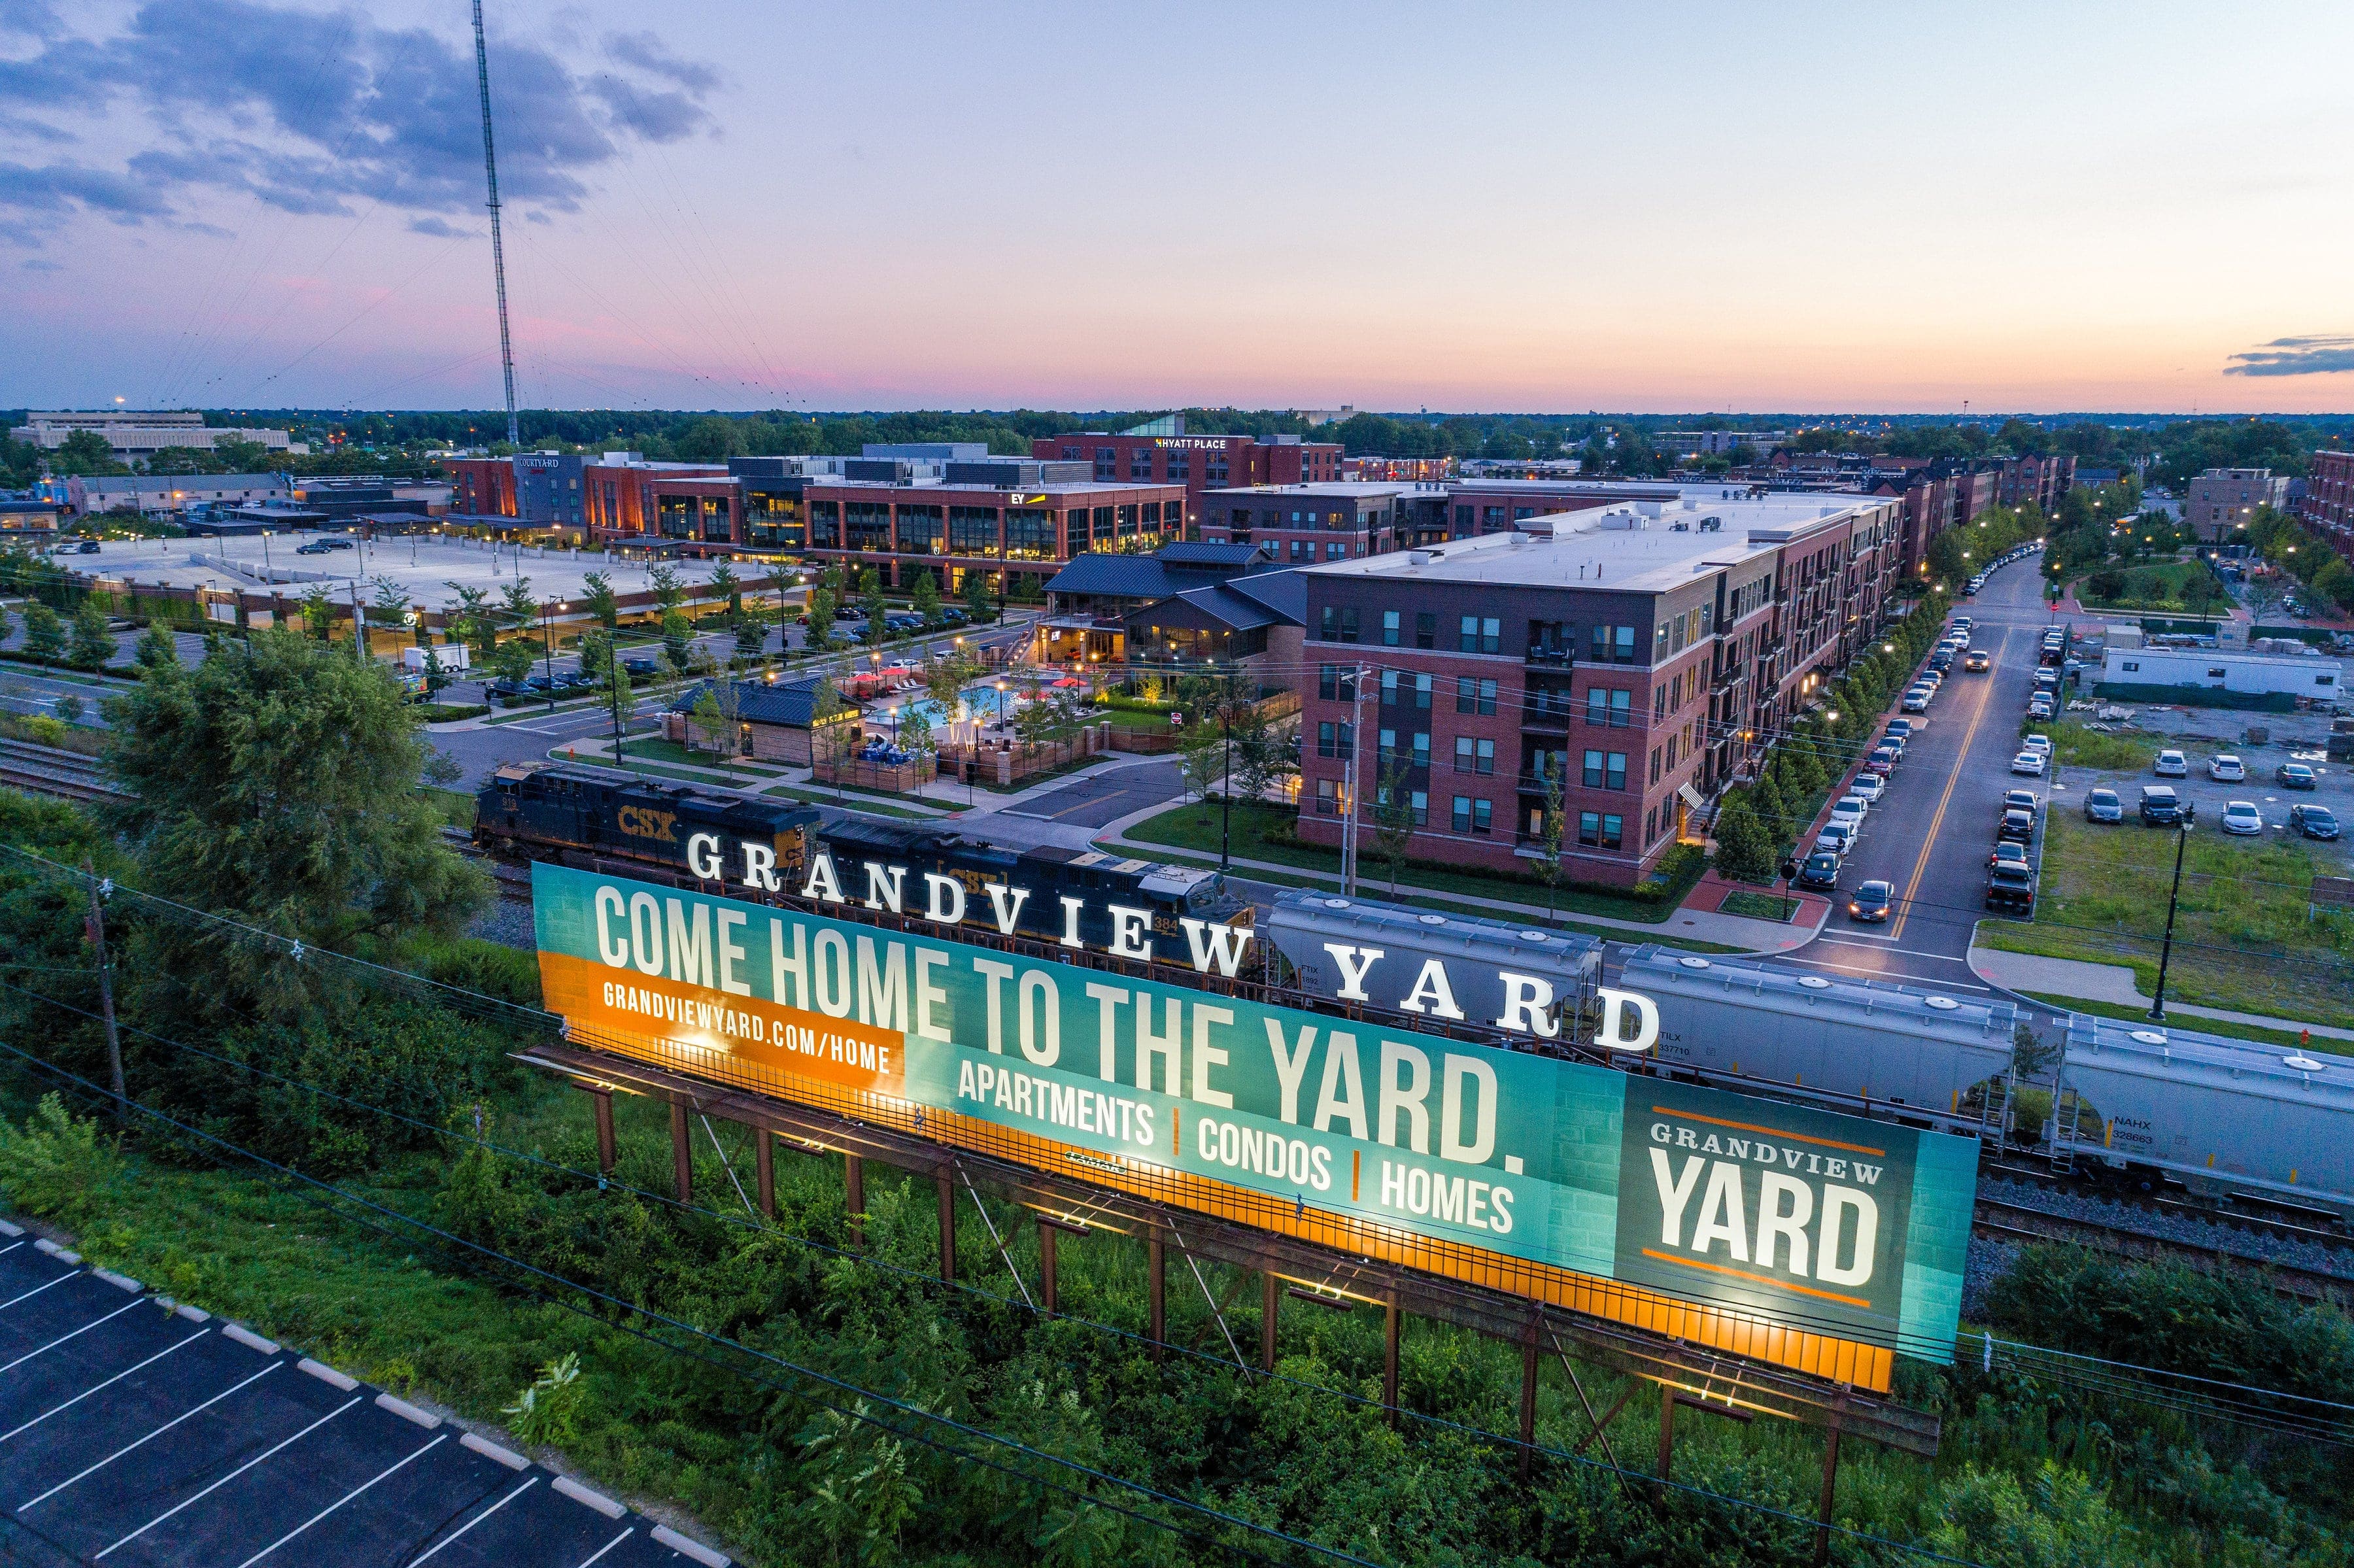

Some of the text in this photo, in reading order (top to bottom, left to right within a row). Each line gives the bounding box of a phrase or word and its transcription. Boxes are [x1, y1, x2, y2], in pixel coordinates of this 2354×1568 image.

[1163, 439, 1225, 449] HYATT PLACE
[519, 458, 558, 468] COURTYARD
[1011, 494, 1025, 504] EY
[618, 805, 677, 842] CSX
[688, 833, 1659, 1051] GRANDVIEW YARD
[1301, 964, 1318, 974] FTIX
[595, 886, 1524, 1175] COME HOME TO THE YARD.
[604, 982, 890, 1074] GRANDVIEWYARD.COM/HOME
[1660, 1031, 1680, 1042] TILX
[1659, 1044, 1690, 1055] 337710
[2115, 1116, 2151, 1131] NAHX
[2113, 1130, 2152, 1144] 328663
[958, 1061, 1513, 1233] APARTMENTS CONDOS HOMES
[1651, 1123, 1883, 1185] GRANDVIEW
[1068, 1152, 1120, 1173] LAMAR
[1649, 1147, 1879, 1287] YARD
